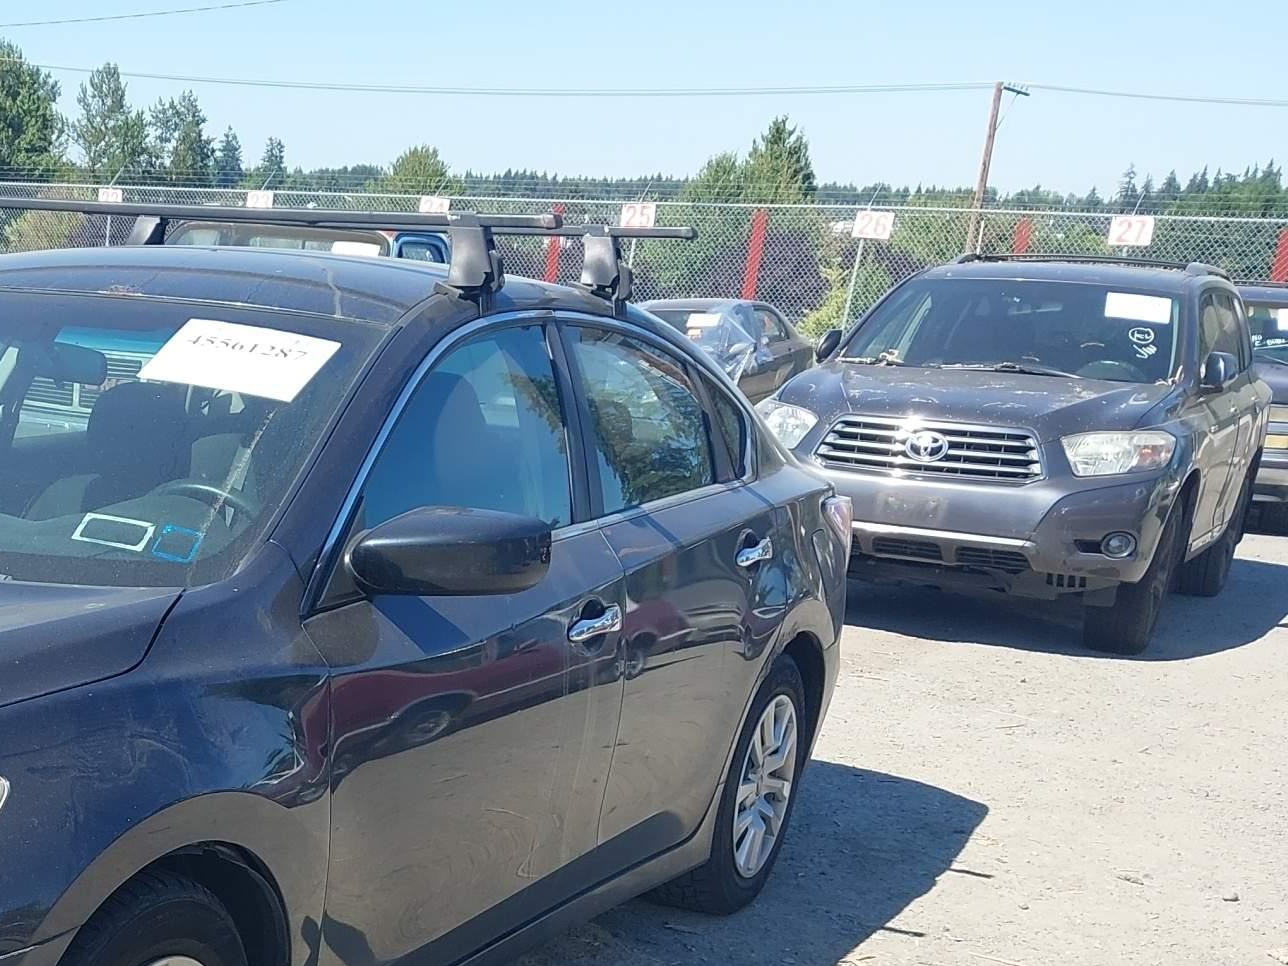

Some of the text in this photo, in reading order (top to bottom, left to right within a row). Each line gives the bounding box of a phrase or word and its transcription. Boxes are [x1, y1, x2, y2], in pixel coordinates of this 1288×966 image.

[624, 203, 653, 227] 25
[857, 212, 890, 237] 26
[1115, 218, 1149, 244] 27
[187, 335, 309, 360] 45561287
